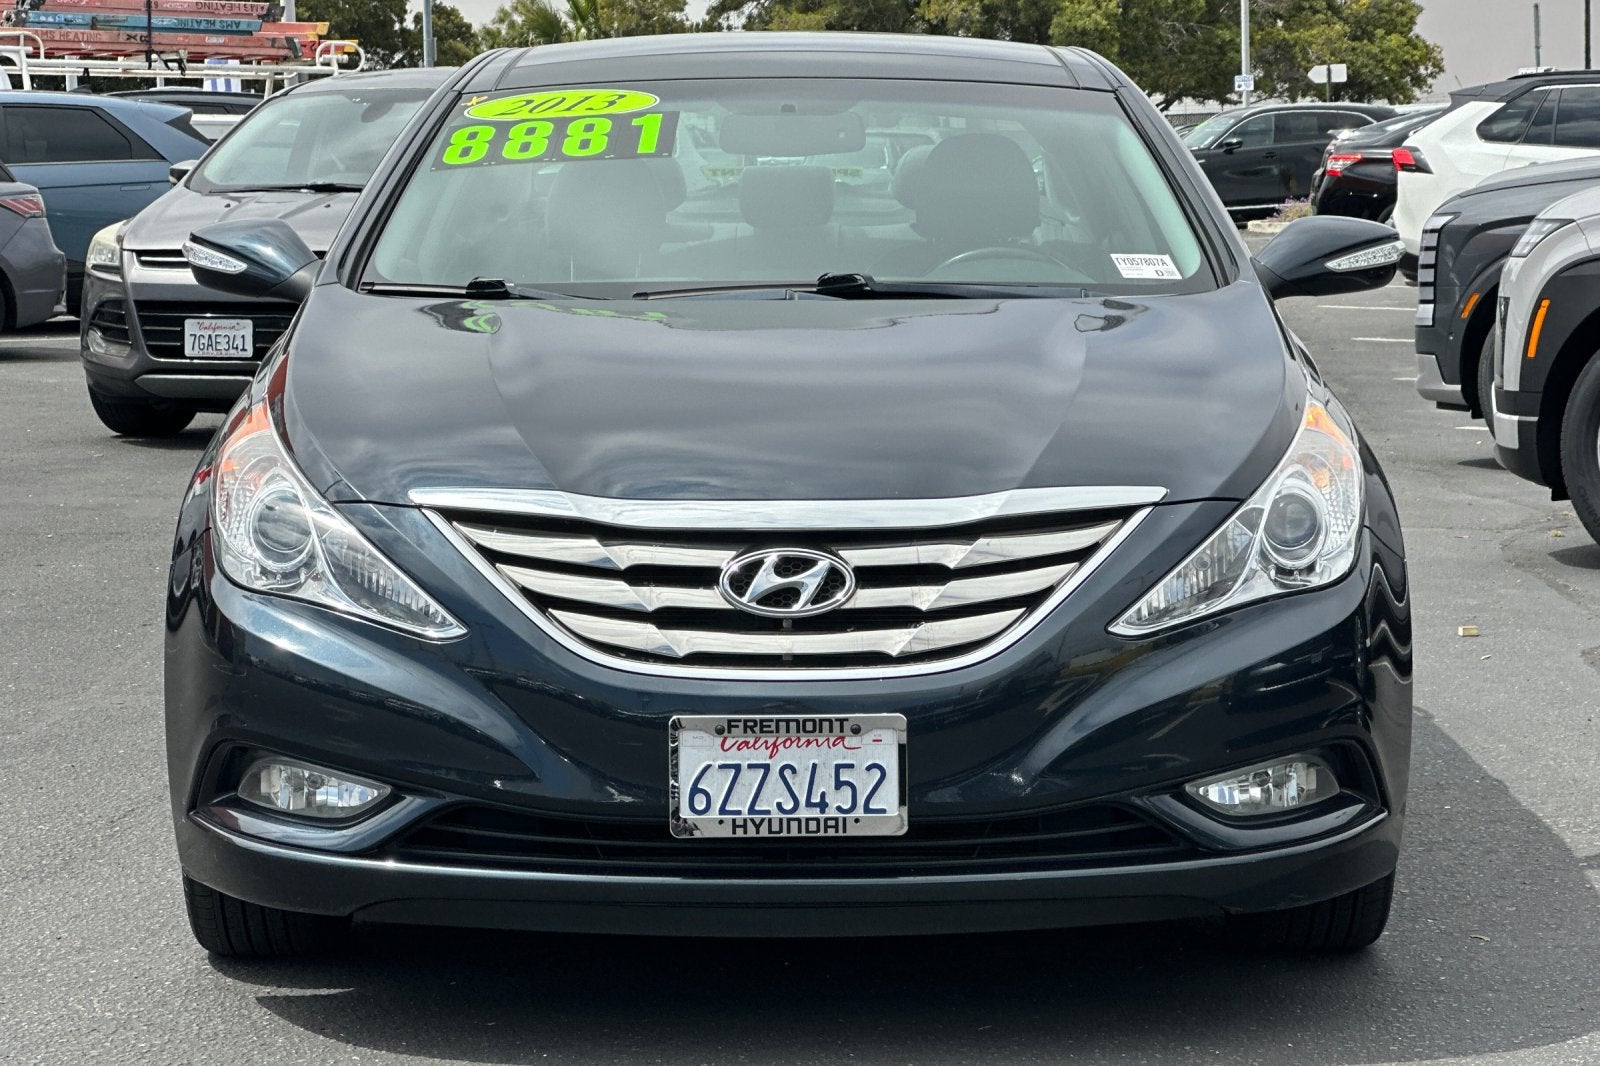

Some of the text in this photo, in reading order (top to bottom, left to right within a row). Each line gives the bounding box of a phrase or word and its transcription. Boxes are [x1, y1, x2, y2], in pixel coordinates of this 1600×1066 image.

[195, 2, 241, 11] HEATING
[219, 20, 241, 29] AMS
[58, 30, 102, 42] HEATING
[495, 93, 627, 116] 2013
[442, 113, 663, 165] 8881
[198, 322, 246, 333] California
[189, 333, 248, 352] 7GAE341
[726, 718, 850, 735] FREMONT
[720, 735, 862, 760] California
[688, 762, 887, 815] 6ZZS452
[731, 817, 848, 836] HYUNDAI
